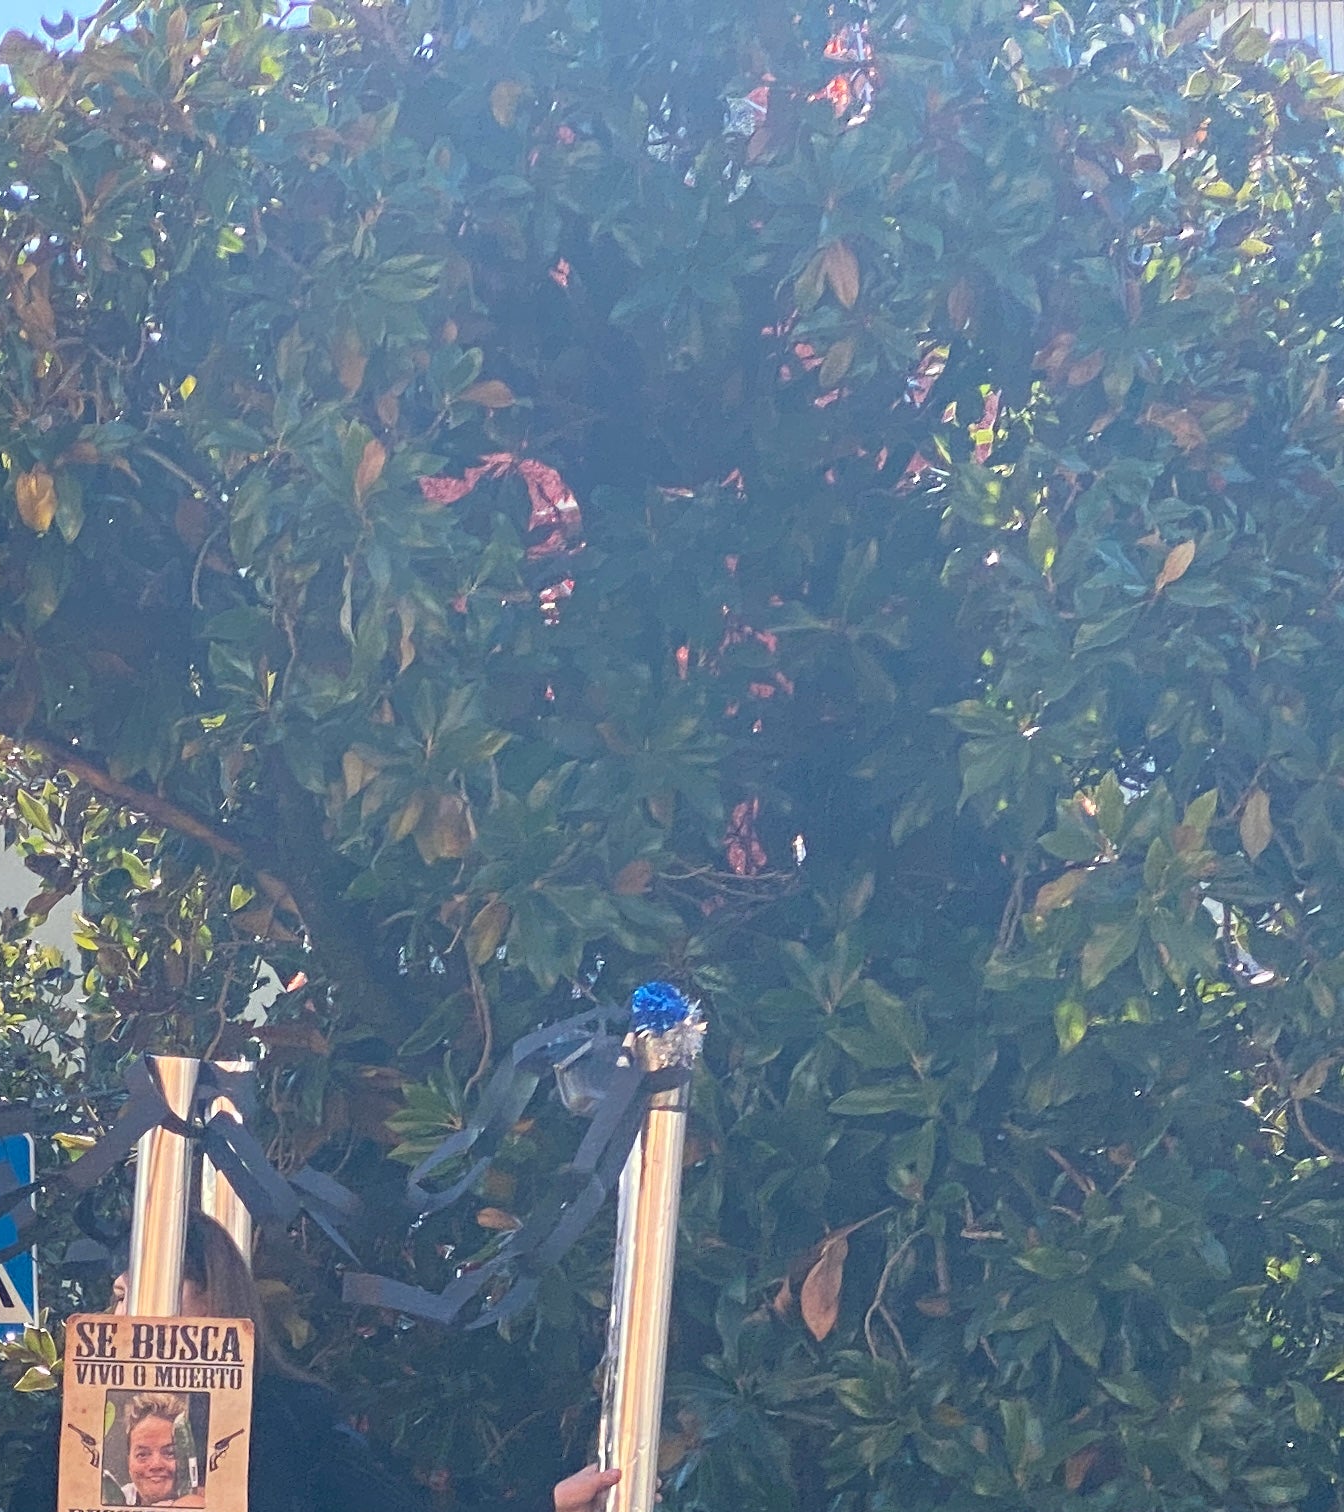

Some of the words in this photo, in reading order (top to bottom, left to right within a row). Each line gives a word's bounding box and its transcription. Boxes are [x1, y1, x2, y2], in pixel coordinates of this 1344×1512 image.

[76, 1321, 118, 1359] SE
[130, 1323, 243, 1362] BUSCA
[76, 1363, 124, 1386] VIVO
[134, 1365, 145, 1386] O
[155, 1366, 243, 1389] MUERTO
